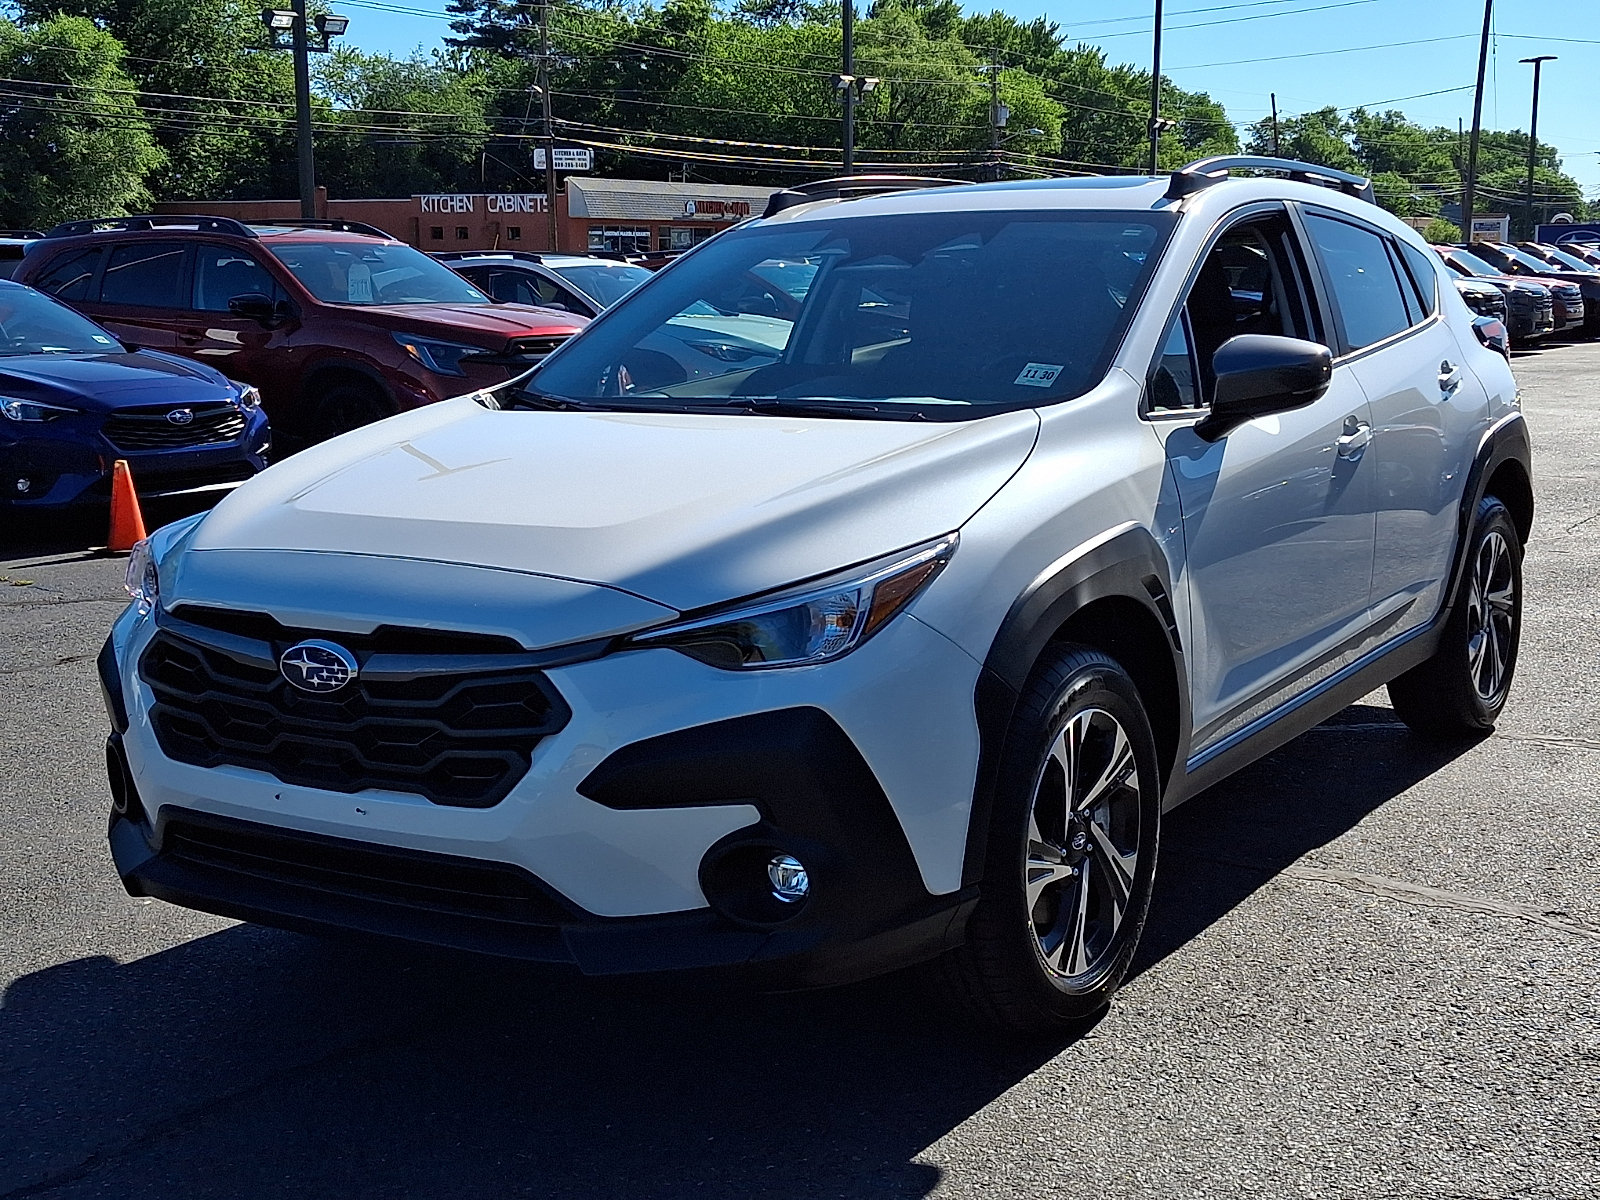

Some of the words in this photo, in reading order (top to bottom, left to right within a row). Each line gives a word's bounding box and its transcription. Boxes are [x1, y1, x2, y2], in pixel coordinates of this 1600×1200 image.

[420, 196, 474, 213] KITCHEN
[487, 195, 549, 213] CABINETS
[1023, 369, 1039, 379] 11
[1039, 370, 1055, 380] 30
